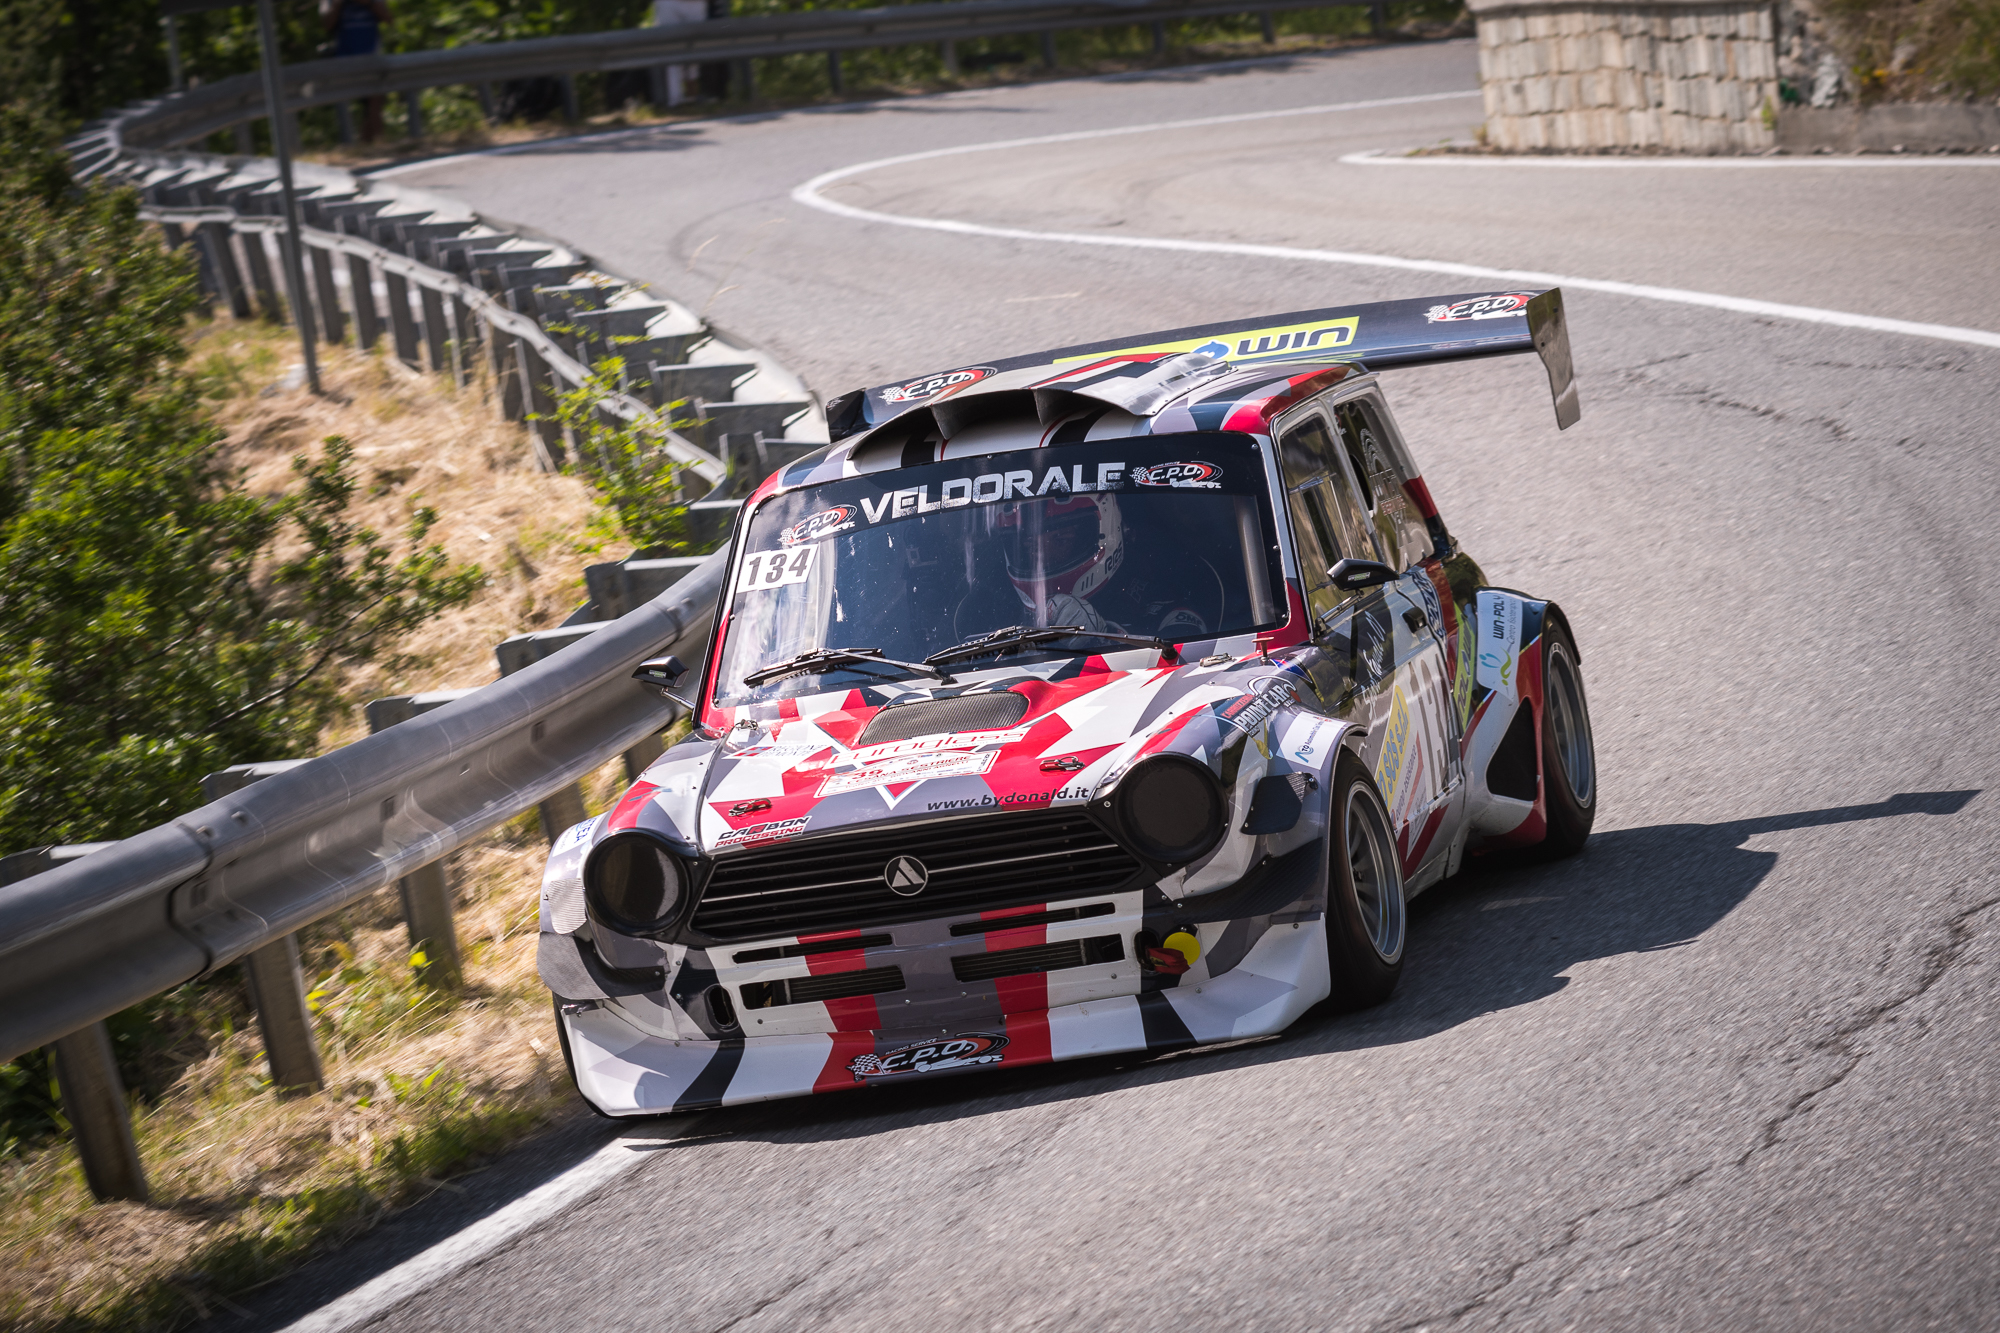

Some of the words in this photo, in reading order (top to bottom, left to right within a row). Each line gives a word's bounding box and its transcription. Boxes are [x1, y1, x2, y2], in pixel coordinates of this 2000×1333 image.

[1449, 296, 1515, 317] C.P.O.
[906, 372, 970, 397] C.P.O.
[1150, 465, 1201, 480] C.P.O.
[860, 462, 1125, 524] VELDORALE
[795, 510, 838, 537] C.P.O.
[748, 548, 811, 587] 134
[1233, 697, 1268, 731] POINT
[1265, 685, 1290, 708] CAR
[1383, 728, 1399, 794] SOS
[927, 786, 1090, 811] www.bydonald.it
[718, 817, 810, 840] CARBON
[882, 1039, 972, 1069] C.P.O.
